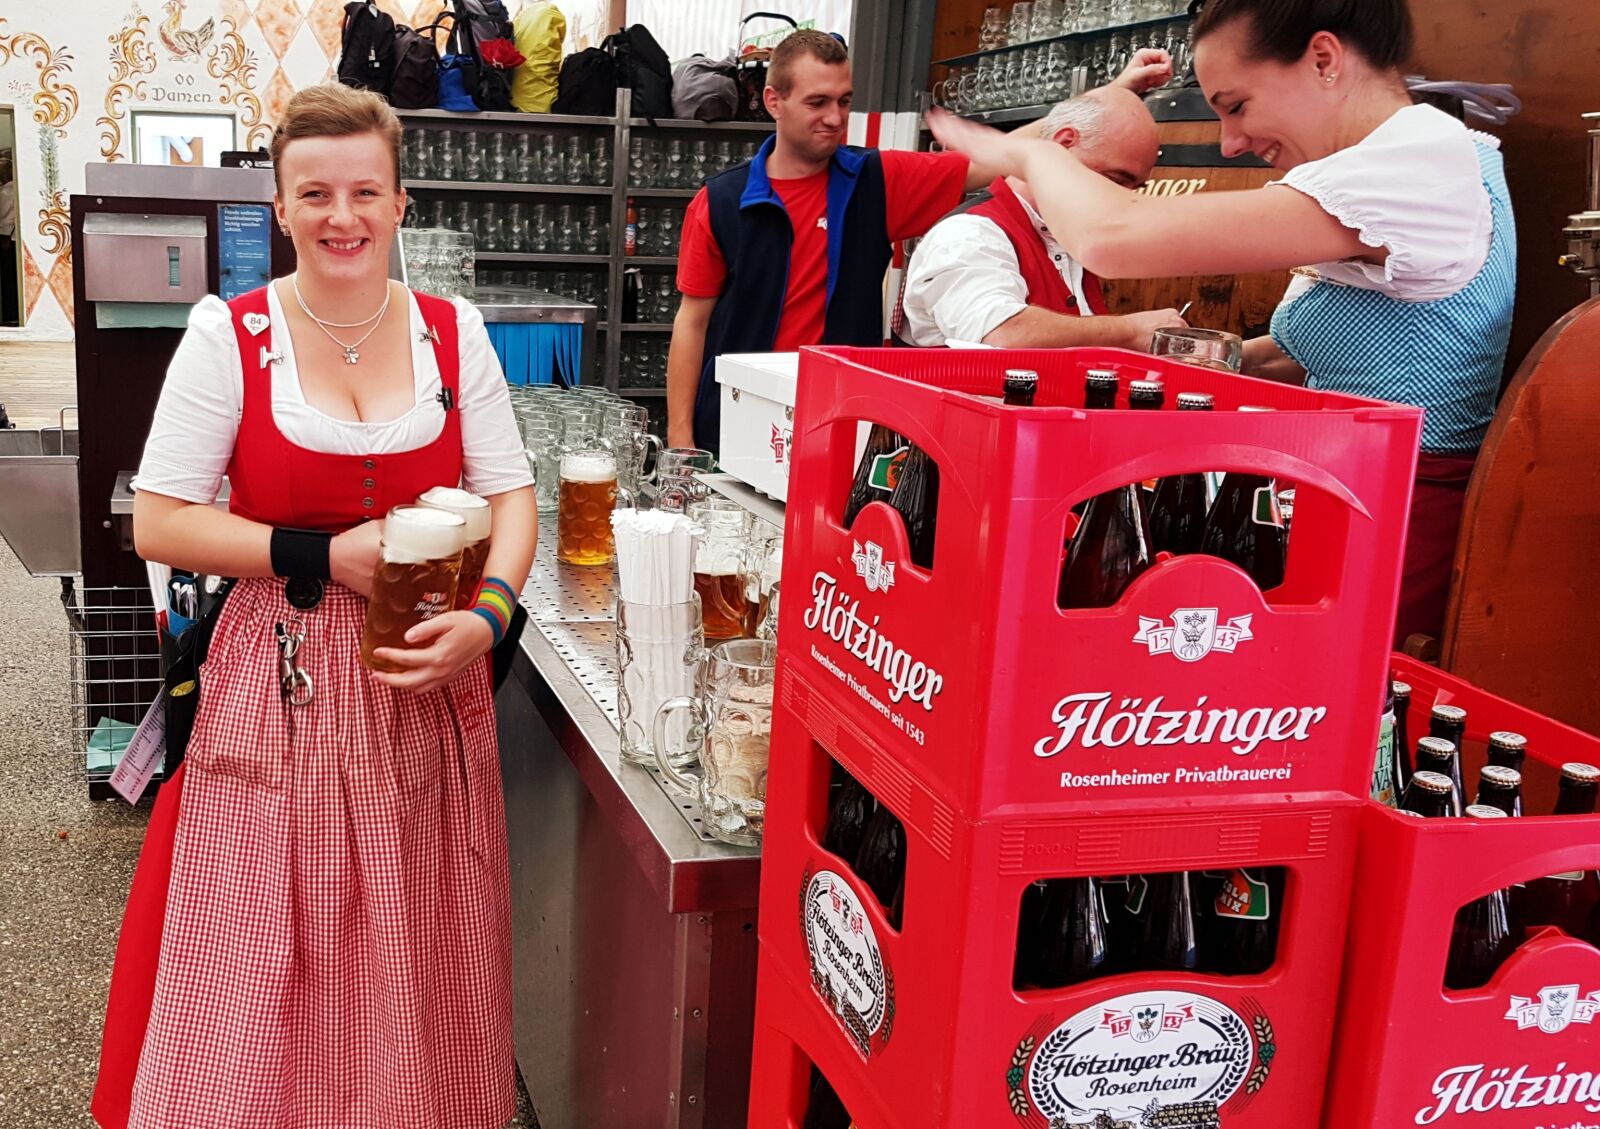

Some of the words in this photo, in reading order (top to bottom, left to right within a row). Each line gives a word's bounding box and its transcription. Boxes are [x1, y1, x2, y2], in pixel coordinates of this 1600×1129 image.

[152, 87, 214, 103] Damen
[250, 316, 262, 325] 84
[804, 571, 943, 711] Flötzinger
[1152, 631, 1170, 649] 15
[811, 643, 847, 682] Rosenheimer
[847, 672, 891, 719] Privatbrauerei
[891, 711, 905, 732] seit
[905, 720, 925, 746] 1543
[1033, 691, 1327, 757] Flötzinger
[1060, 768, 1171, 788] Rosenheimer
[1175, 763, 1293, 784] Privatbrauerei
[808, 899, 855, 963] Flötzinger
[852, 952, 880, 998] Bräu
[822, 939, 864, 1002] Rosenheim
[1113, 1020, 1129, 1033] 15
[1522, 1008, 1536, 1025] 15
[1043, 1051, 1165, 1083] Flötzinger
[1169, 1042, 1237, 1068] Bräu
[1085, 1072, 1197, 1099] Rosenheim
